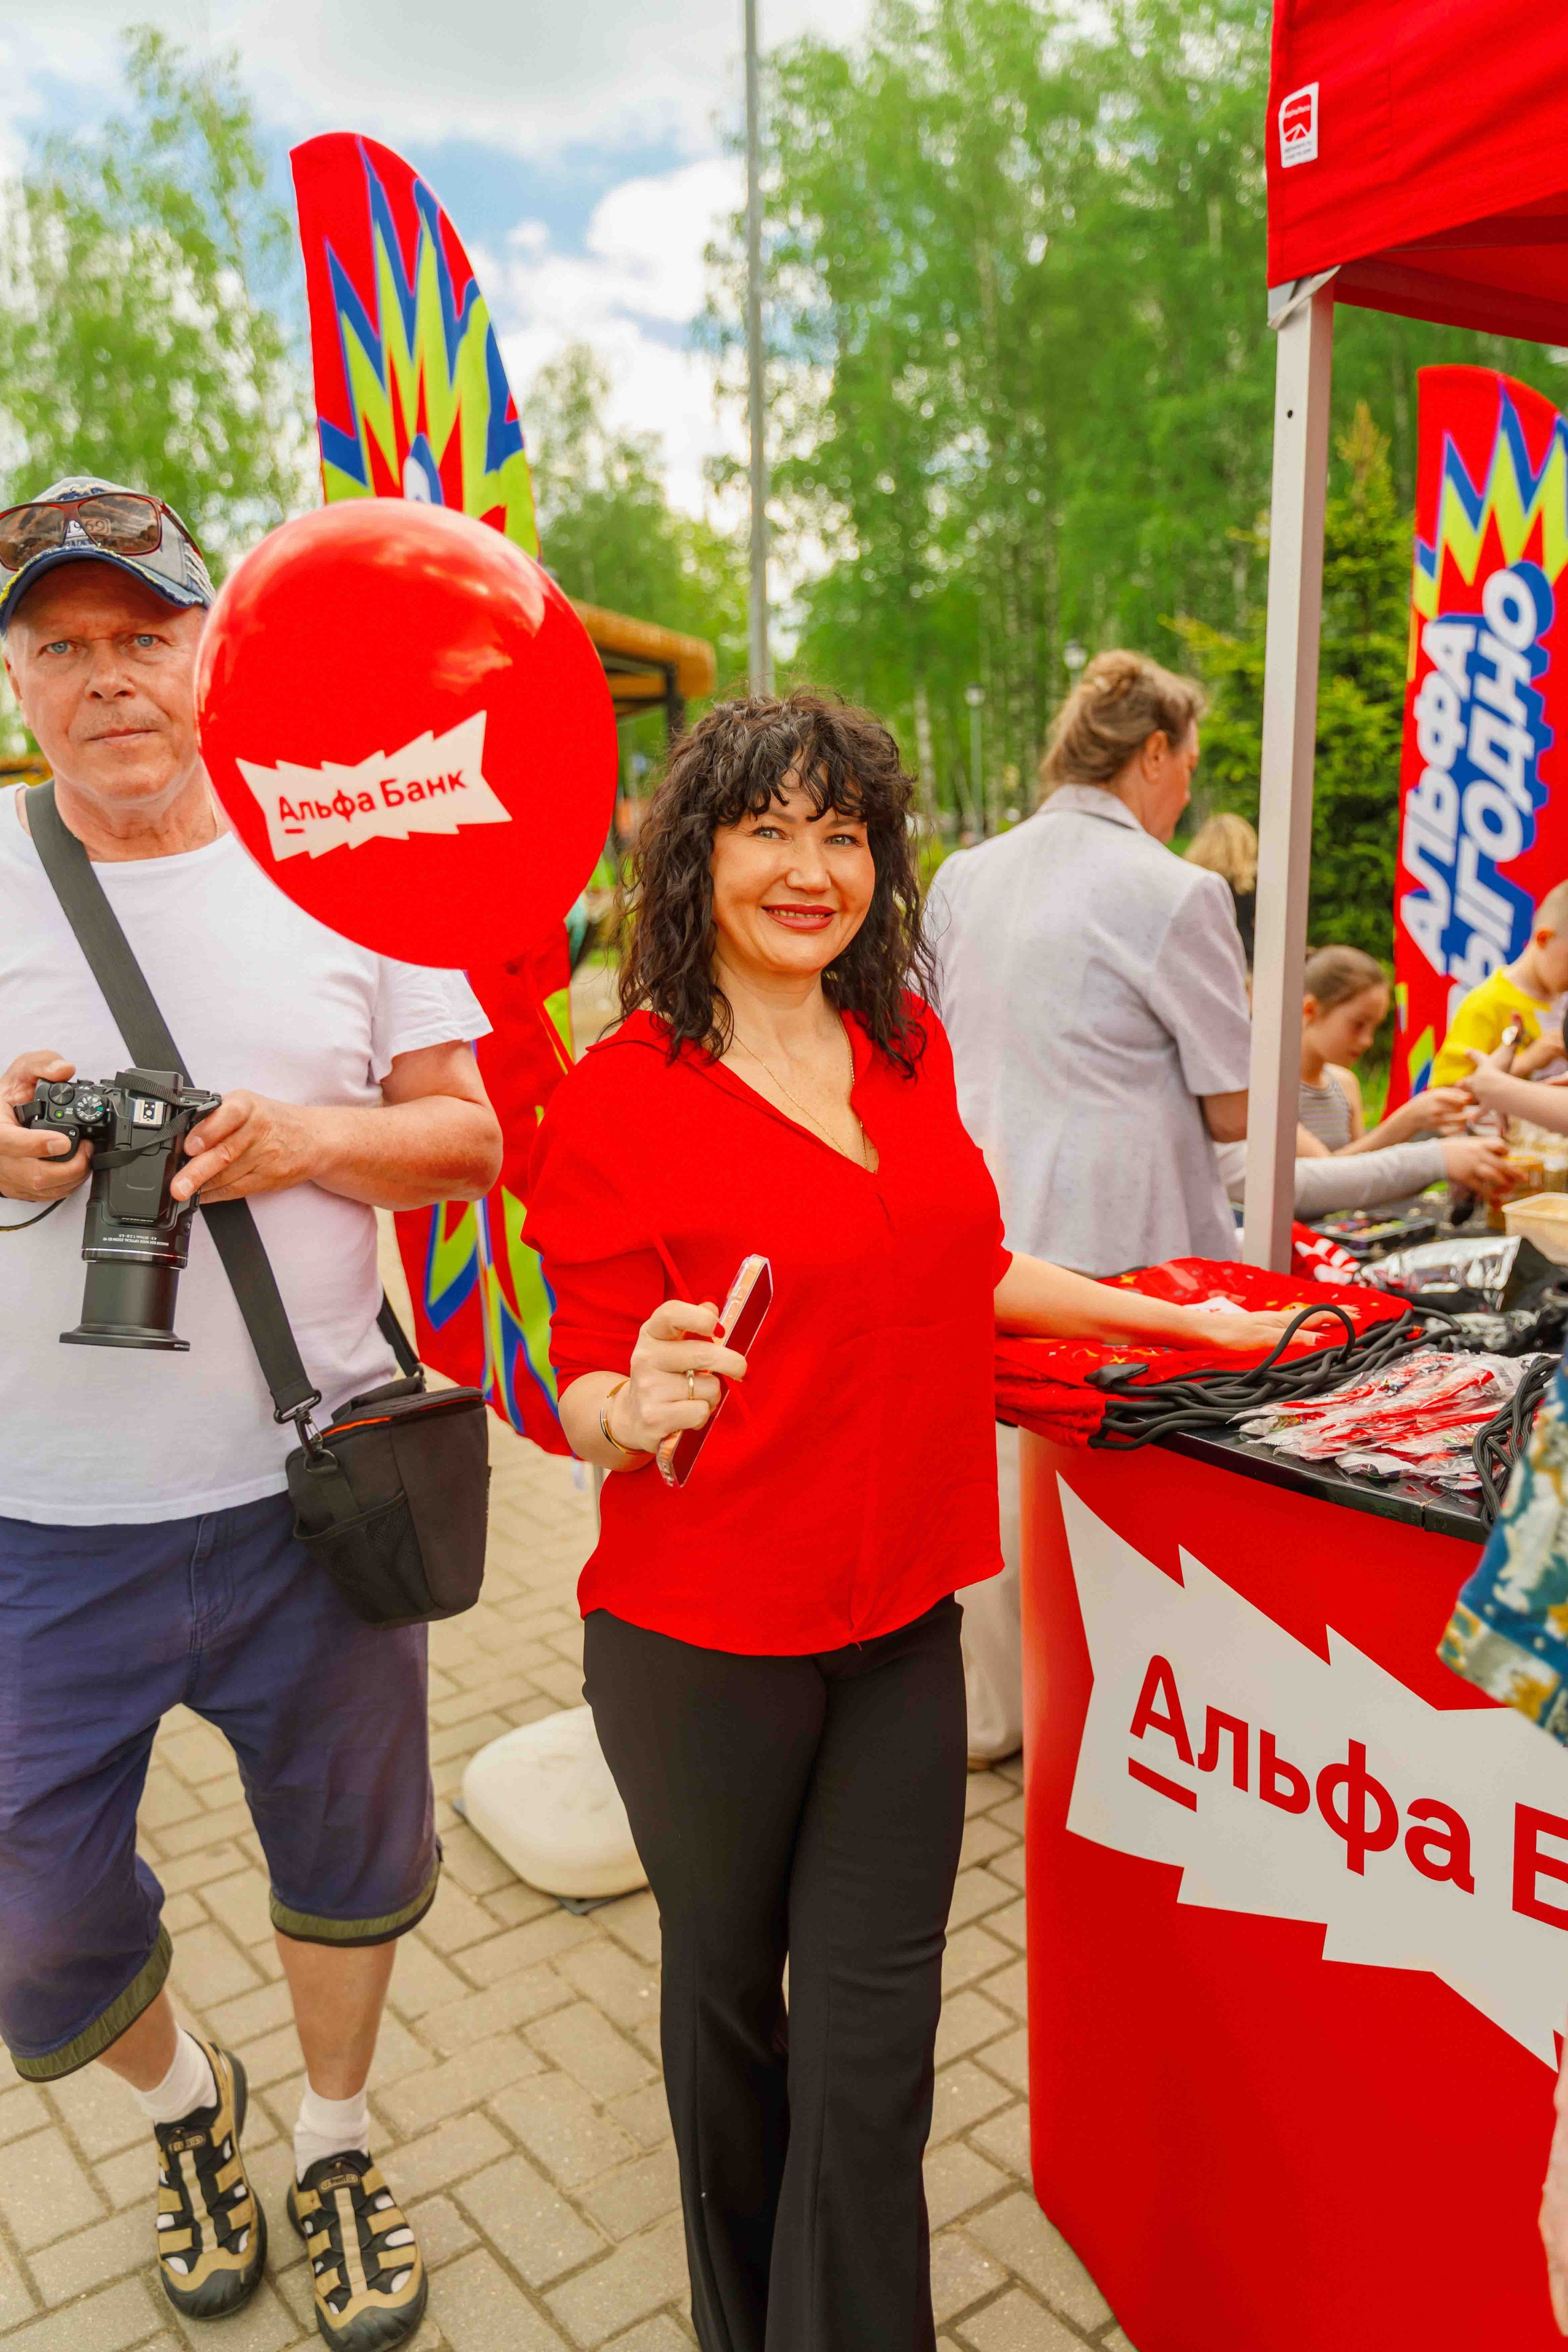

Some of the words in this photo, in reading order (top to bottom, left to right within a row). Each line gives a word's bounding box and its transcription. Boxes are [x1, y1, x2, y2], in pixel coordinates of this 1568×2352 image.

[279, 788, 377, 823] Альфа
[379, 769, 468, 808] Банк
[1400, 621, 1476, 977] АЛЬФА
[1446, 568, 1536, 1029] ЫГОДНО
[1129, 1654, 1475, 1895] Альфа
